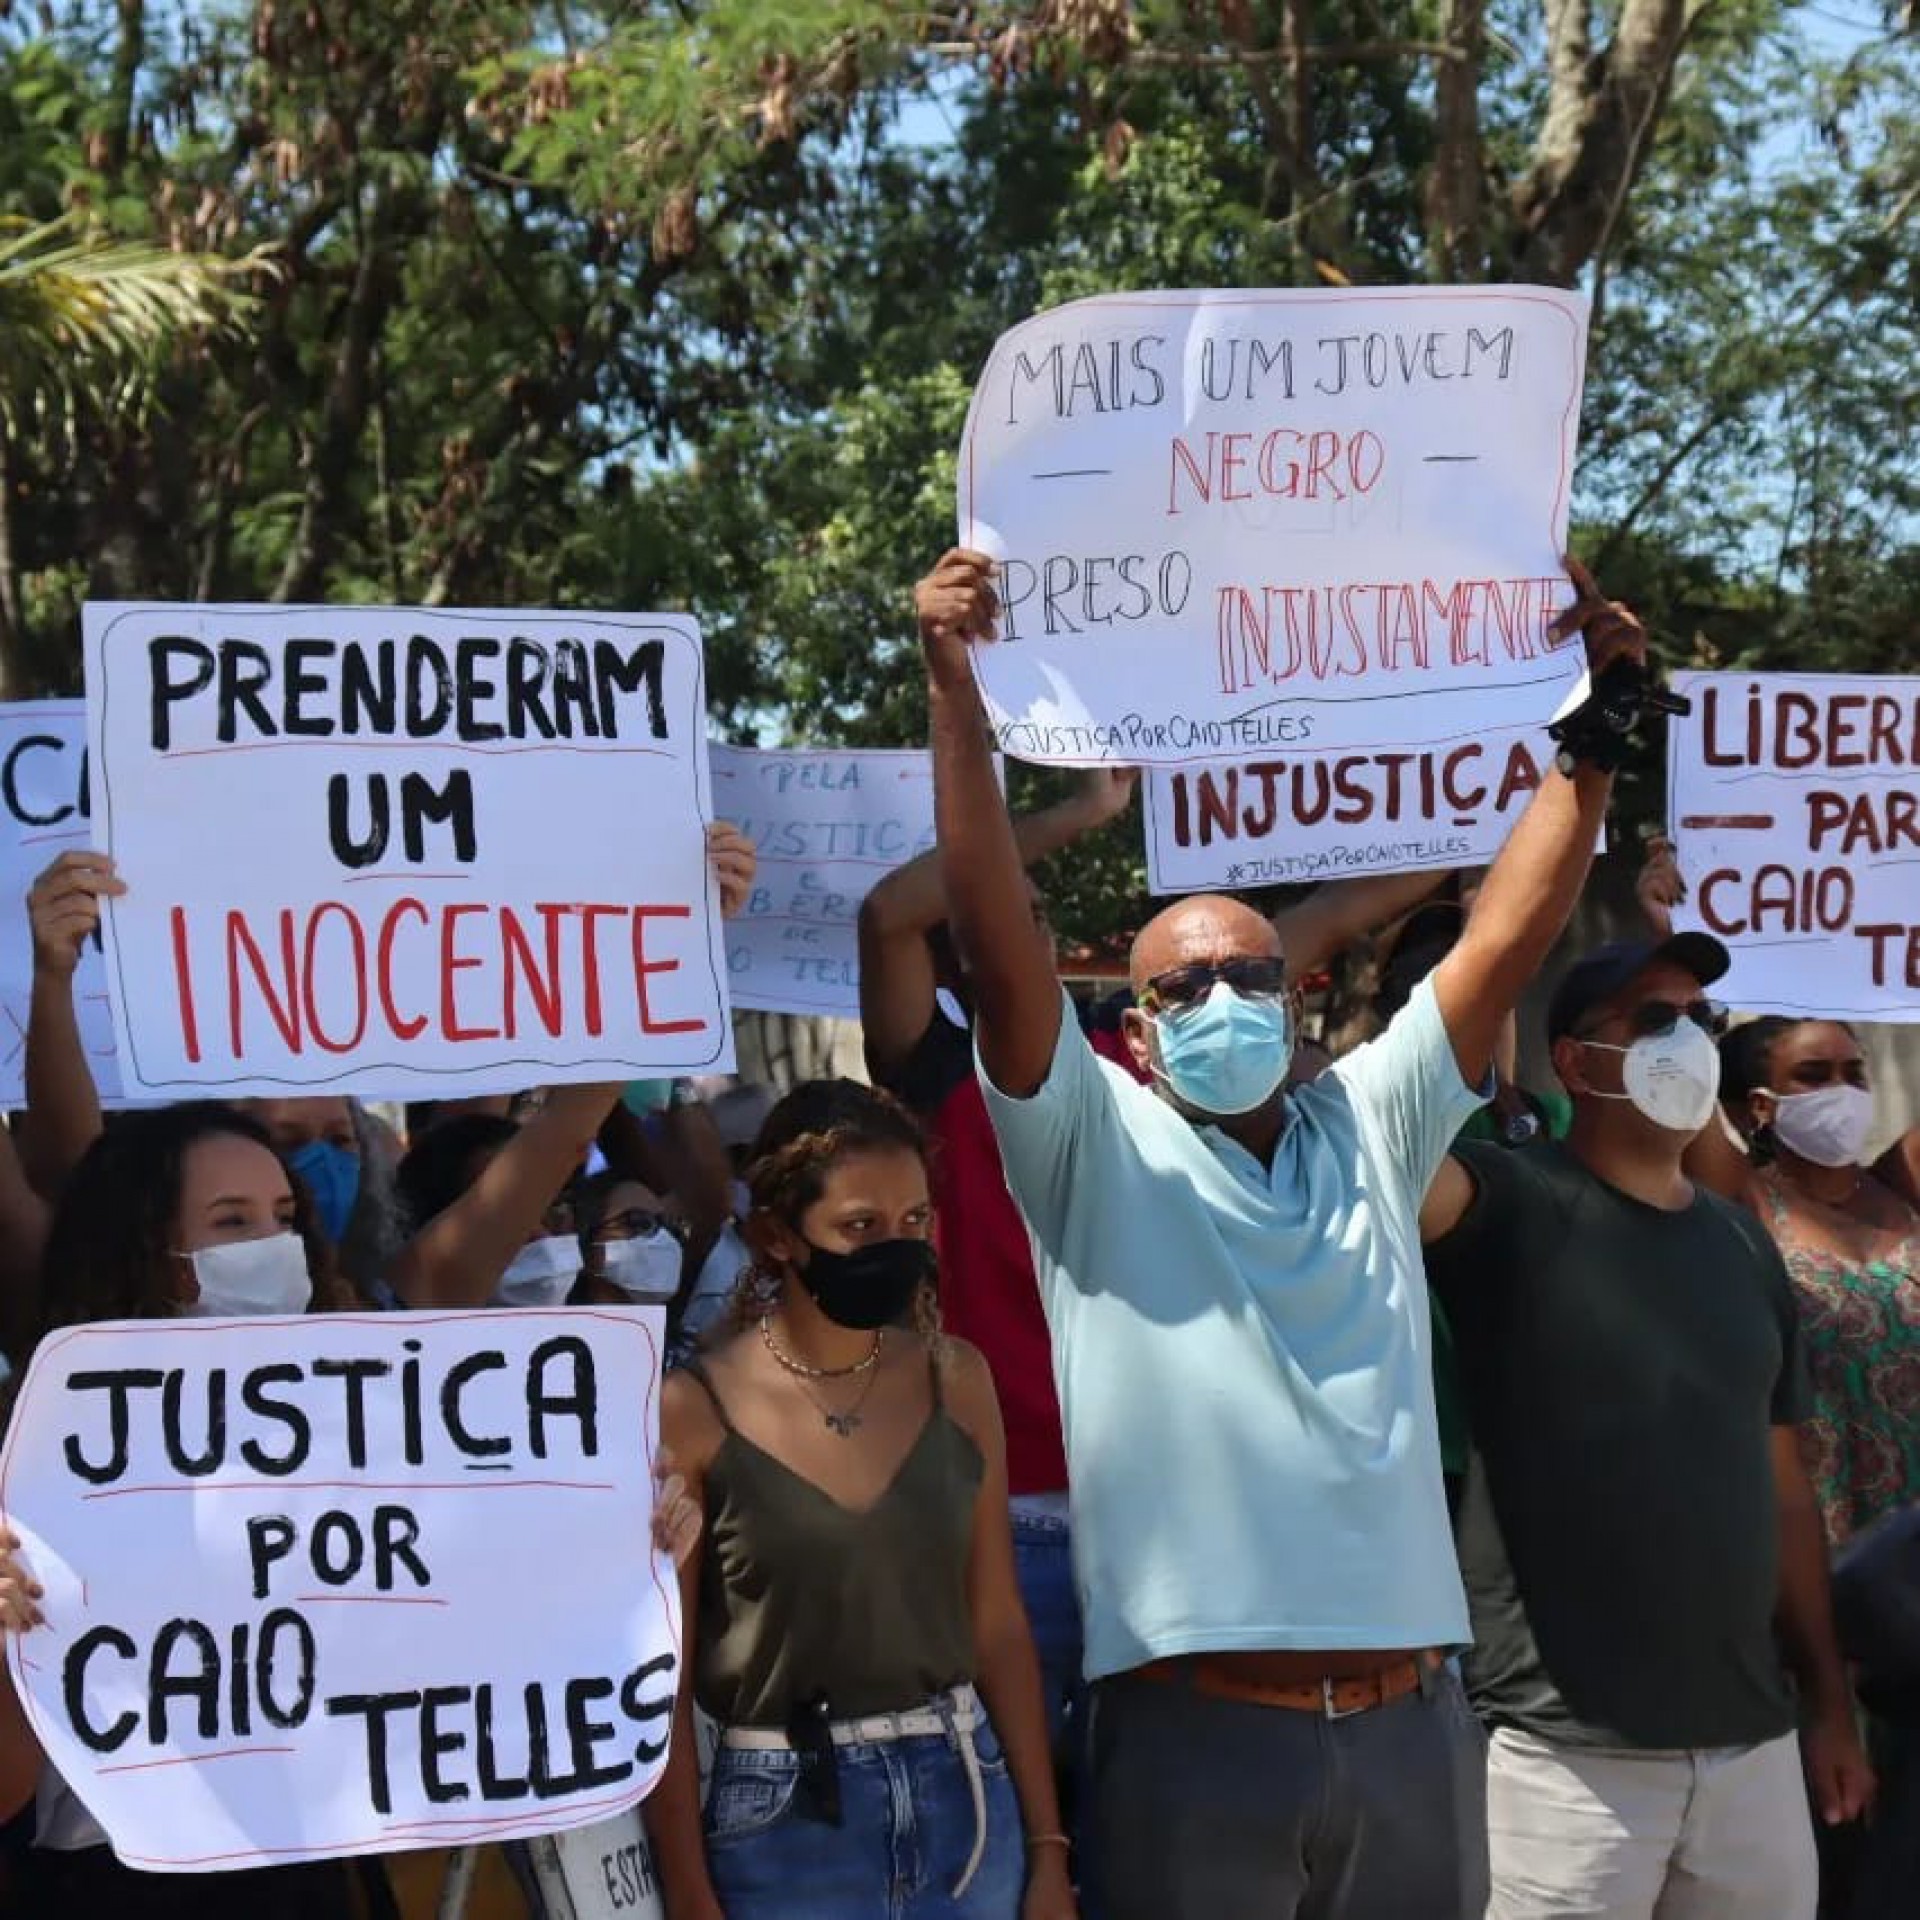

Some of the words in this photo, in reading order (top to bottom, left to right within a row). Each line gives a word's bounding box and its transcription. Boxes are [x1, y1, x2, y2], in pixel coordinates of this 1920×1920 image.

[1007, 335, 1165, 424] MAIS
[1201, 337, 1296, 402] UM
[1314, 327, 1514, 396] JOVEM
[1167, 429, 1385, 514] NEGRO
[999, 550, 1193, 641] PRESO
[148, 635, 669, 752] PRENDERAM
[1703, 684, 1920, 768] LIBER
[328, 769, 478, 870] UM
[760, 760, 863, 793] PELA
[1170, 742, 1544, 848] INJUSTIÇA
[1804, 791, 1920, 854] PAR
[1699, 864, 1854, 935] CAIO
[170, 898, 708, 1063] INOCENTE
[782, 955, 862, 988] TEL
[63, 1335, 599, 1486] JUSTIÇA
[246, 1505, 430, 1599] POR
[62, 1607, 316, 1754] CAIO
[326, 1652, 678, 1815] TELLES
